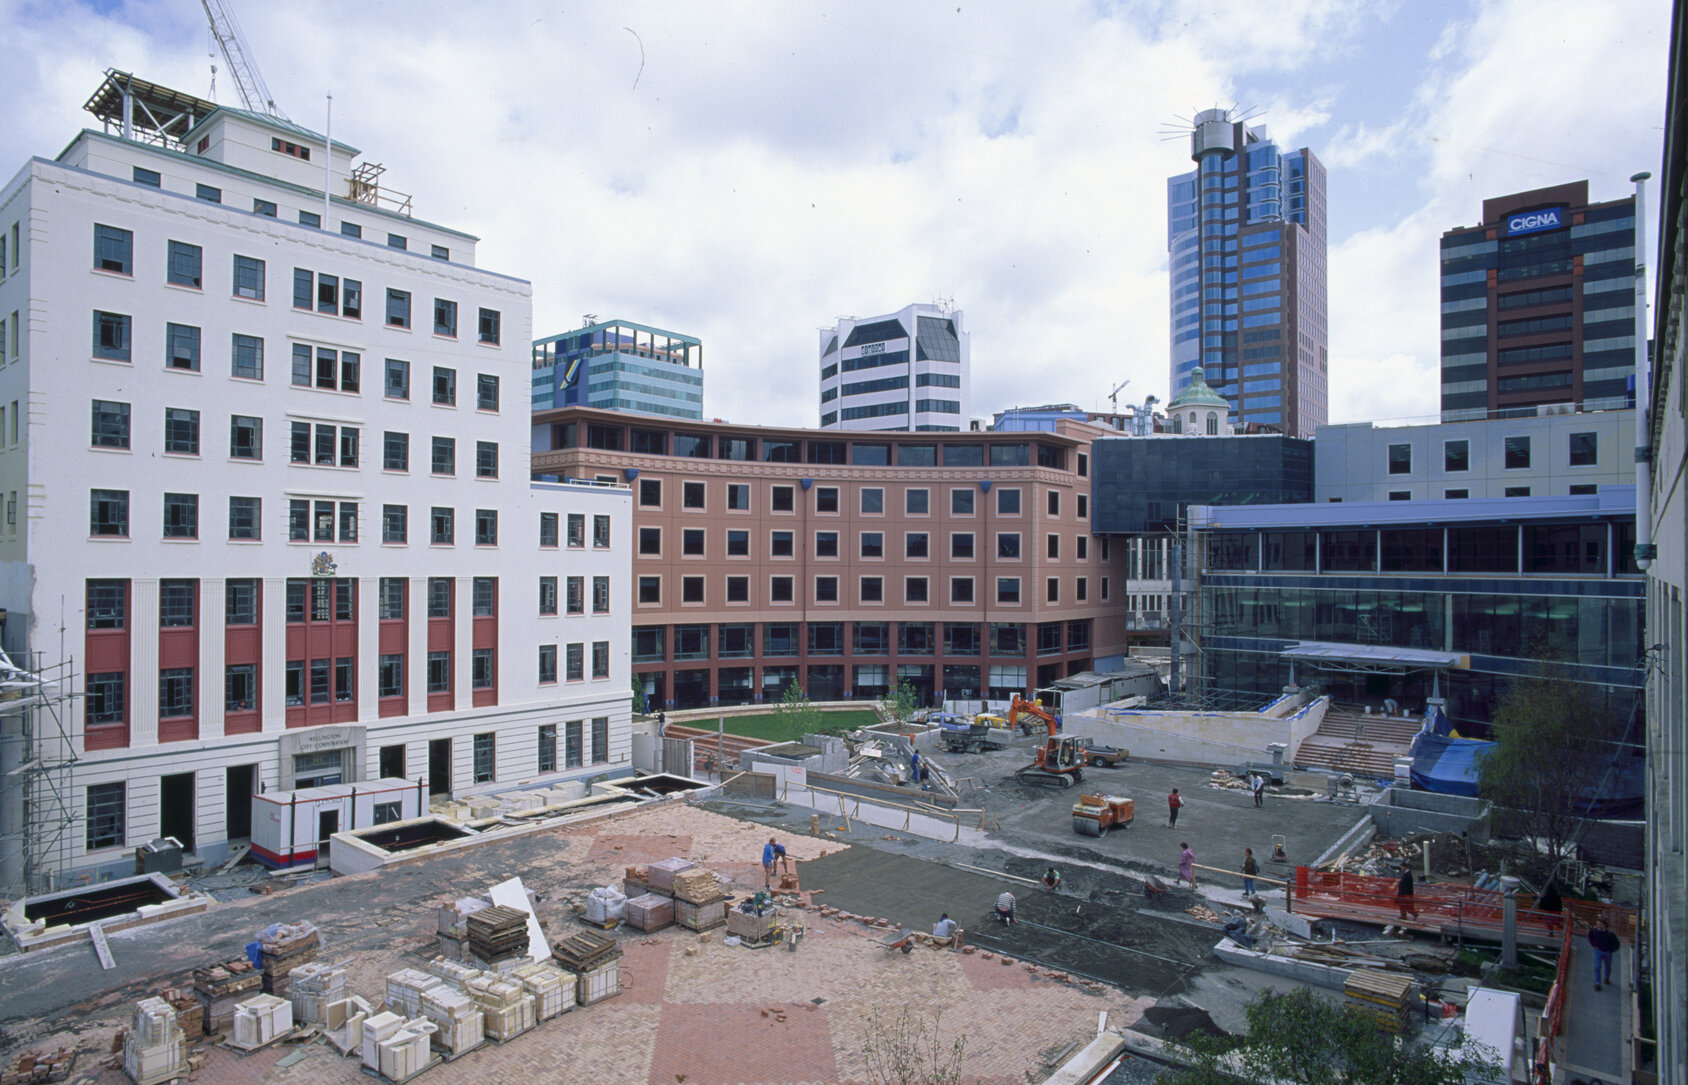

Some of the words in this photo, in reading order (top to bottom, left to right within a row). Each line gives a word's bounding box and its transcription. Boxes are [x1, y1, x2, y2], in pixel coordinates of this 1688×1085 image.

[1510, 212, 1557, 230] CIGNA
[309, 733, 341, 741] WELLINGTON
[315, 739, 348, 749] CORPORATION
